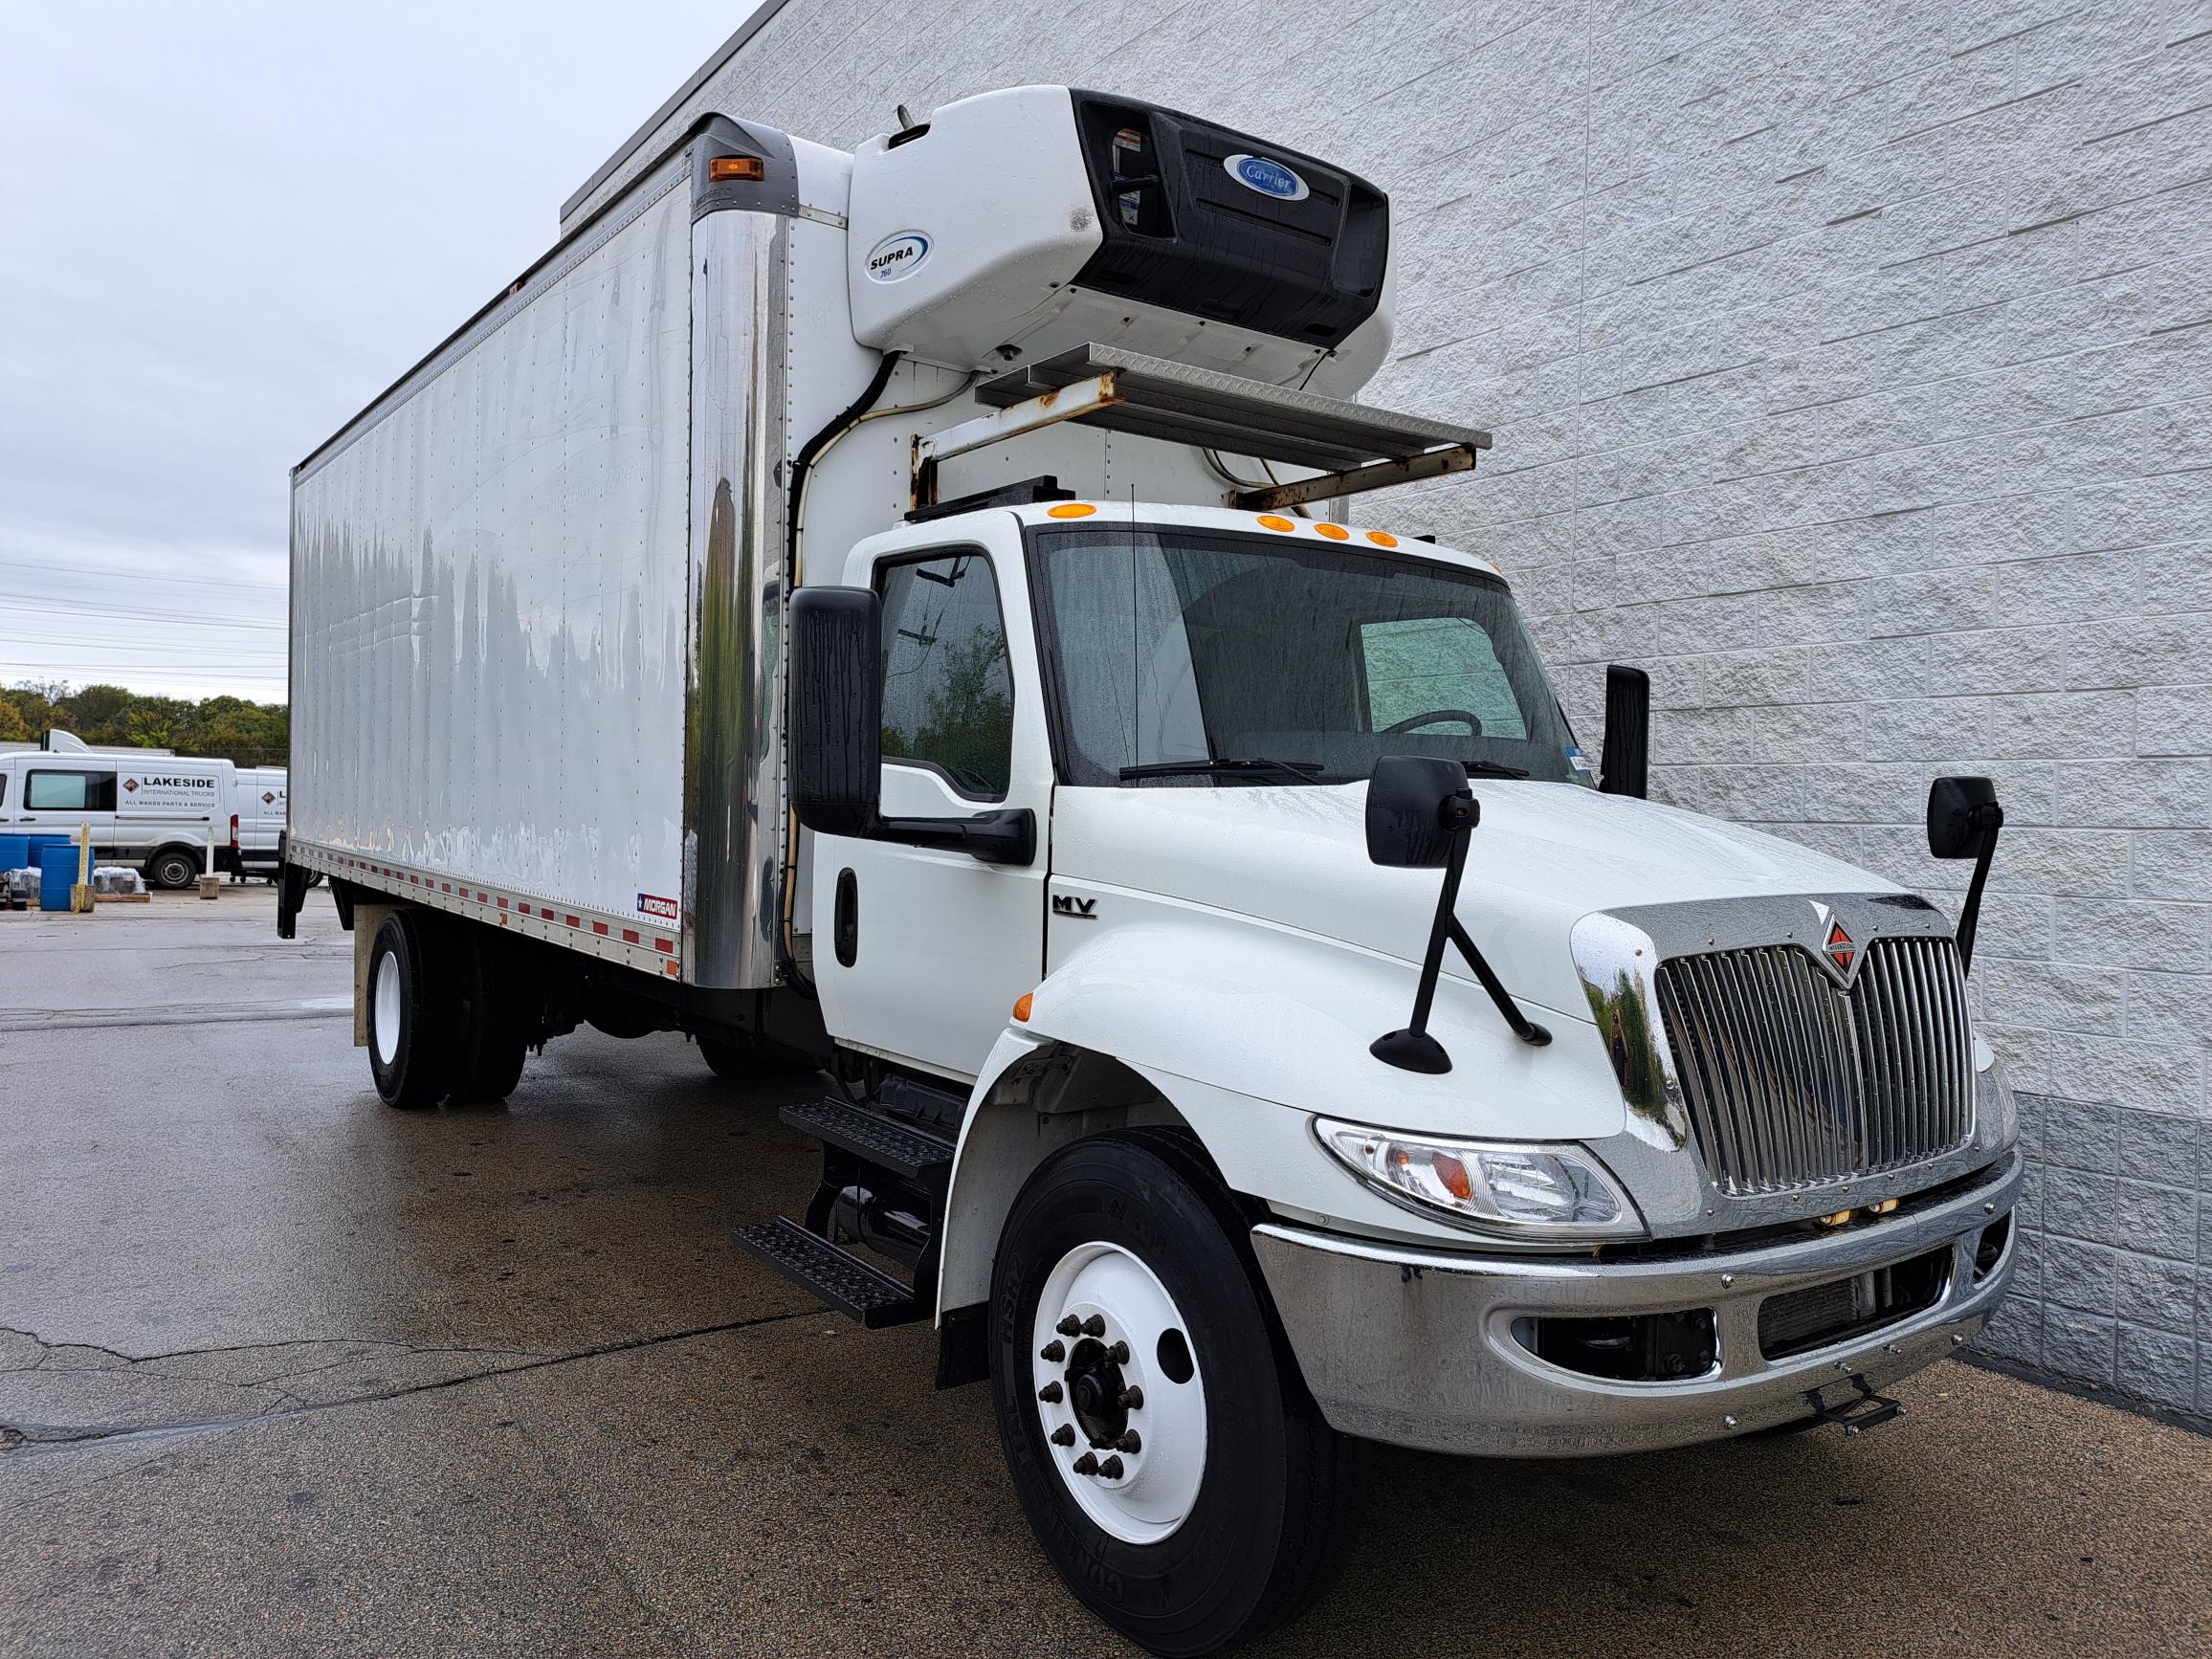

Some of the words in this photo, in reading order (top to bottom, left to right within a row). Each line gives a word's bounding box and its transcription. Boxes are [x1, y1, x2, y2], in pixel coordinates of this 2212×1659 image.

[1246, 165, 1292, 189] Carrier
[870, 246, 914, 271] SUPRA
[879, 268, 892, 278] 760
[144, 777, 215, 788] LAKESIDE
[643, 897, 676, 918] MORGAN
[1052, 894, 1098, 914] MV
